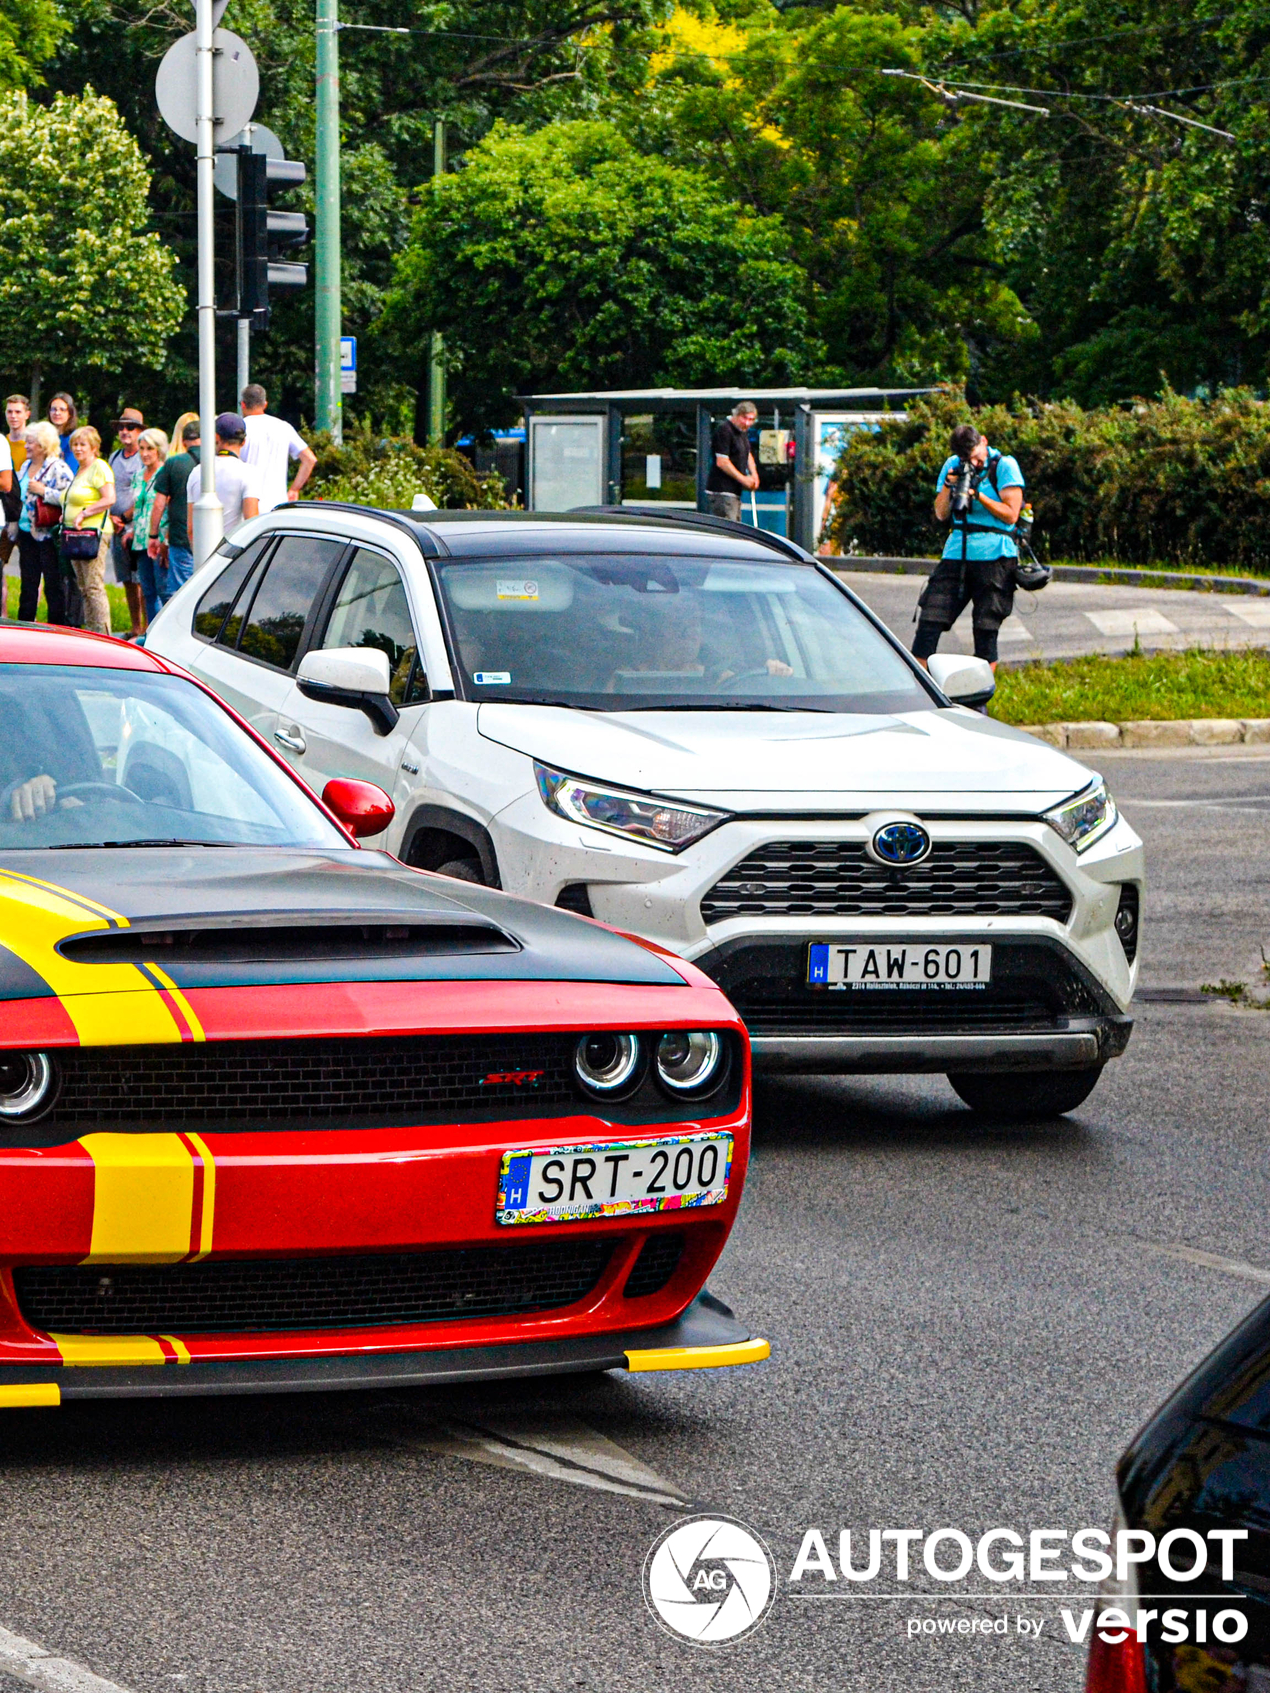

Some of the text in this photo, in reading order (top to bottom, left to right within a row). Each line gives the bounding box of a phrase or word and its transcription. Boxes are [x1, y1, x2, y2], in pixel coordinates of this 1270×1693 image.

[814, 949, 980, 979] H TAW-601
[483, 1071, 544, 1086] SRT
[510, 1144, 719, 1204] H SRT-200
